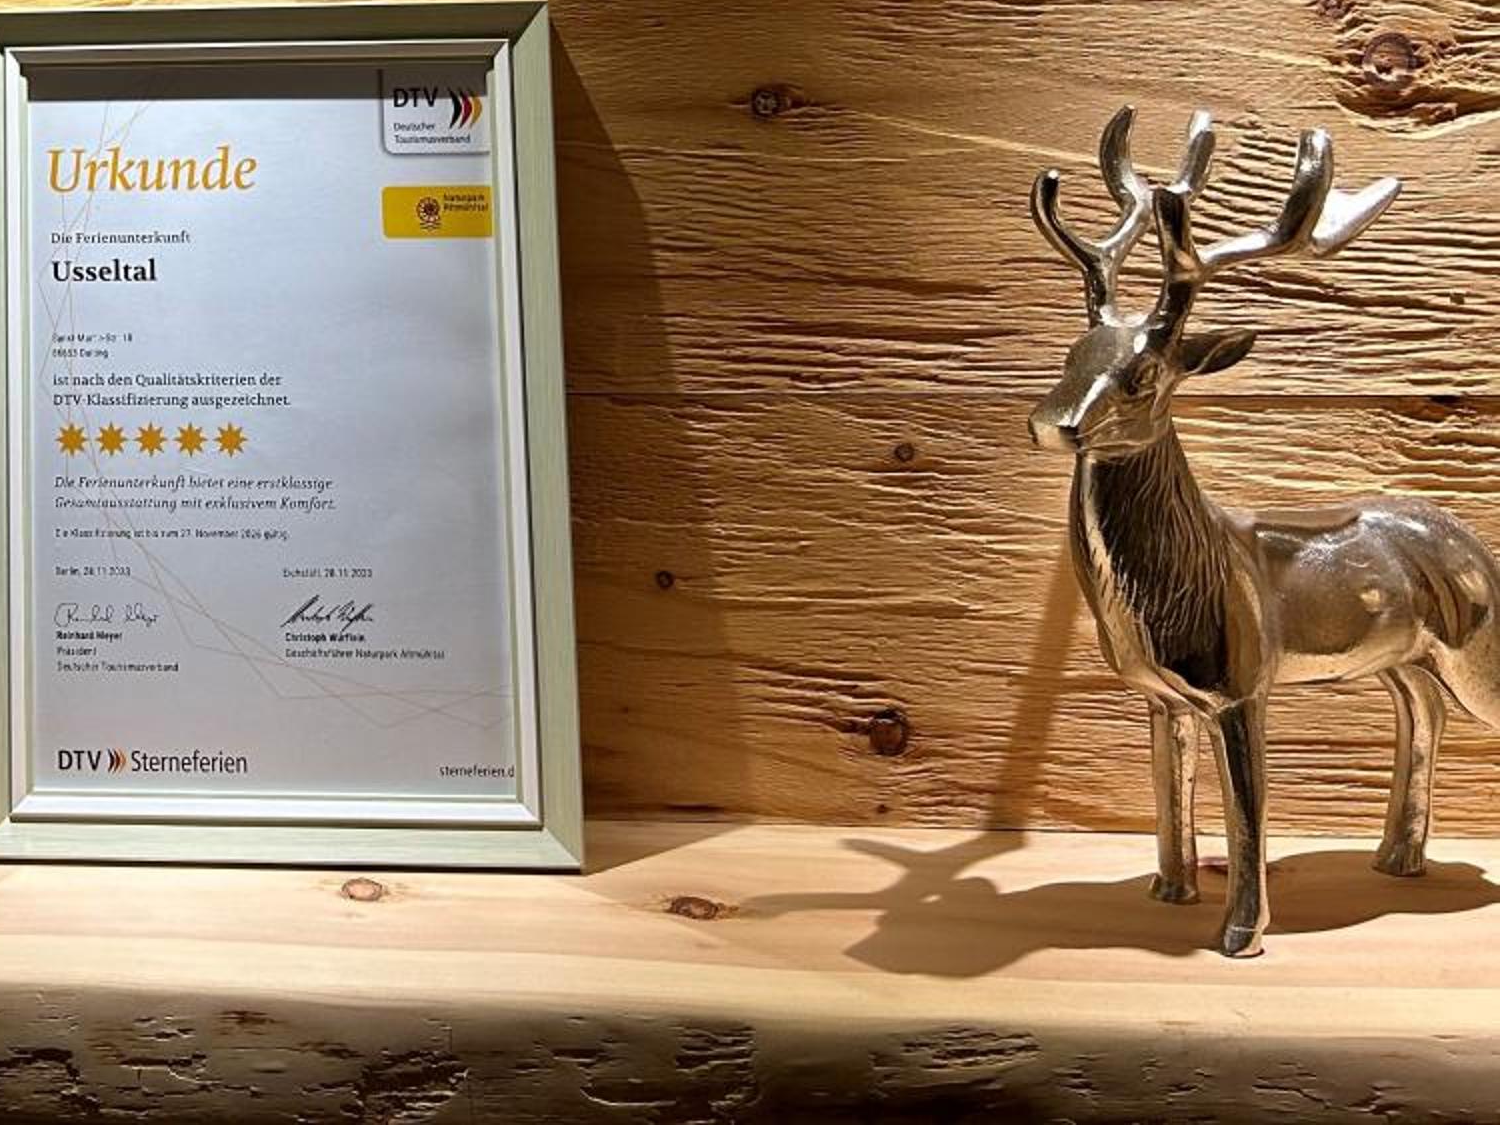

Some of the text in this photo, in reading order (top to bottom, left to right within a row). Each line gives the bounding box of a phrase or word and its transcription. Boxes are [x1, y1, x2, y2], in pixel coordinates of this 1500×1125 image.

[393, 86, 438, 109] DTV
[47, 144, 258, 193] Urkunde
[51, 230, 190, 244] Die Ferienunterkunft
[52, 258, 156, 282] Usseltal
[53, 373, 283, 387] ist nach den Qualitätskriterien der
[54, 476, 75, 488] Die
[79, 475, 186, 493] Ferienunterkunft
[227, 477, 254, 489] eine
[181, 498, 202, 509] mit
[205, 496, 277, 510] exklusivem
[58, 749, 248, 773] DTV Sterneferien
[439, 765, 516, 778] sterneferien.d
